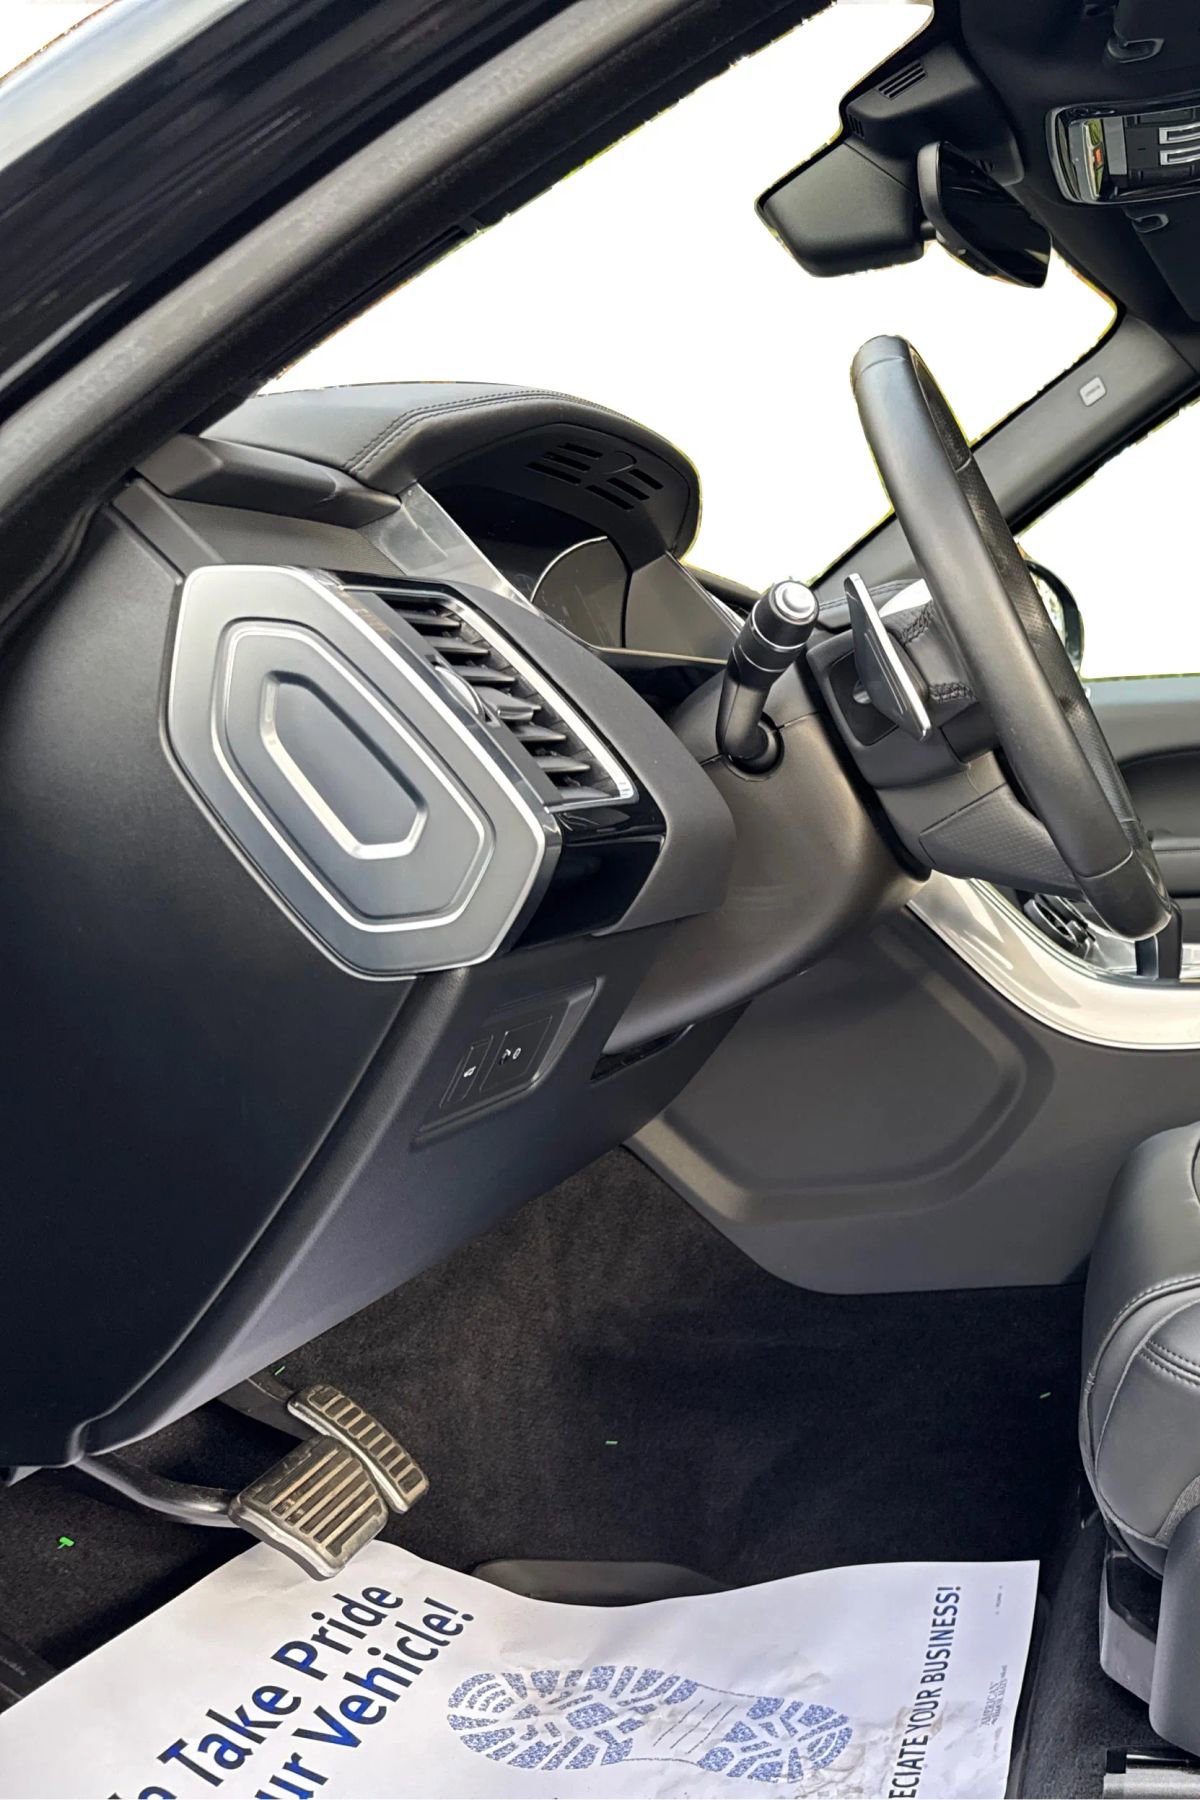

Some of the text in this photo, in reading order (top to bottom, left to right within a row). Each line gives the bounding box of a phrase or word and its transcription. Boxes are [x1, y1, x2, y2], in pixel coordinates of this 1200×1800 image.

[157, 1585, 403, 1787] Take Pride
[294, 1597, 475, 1749] Vehicle!
[920, 1586, 961, 1684] BUSINESS!
[905, 1687, 942, 1735] YOUR
